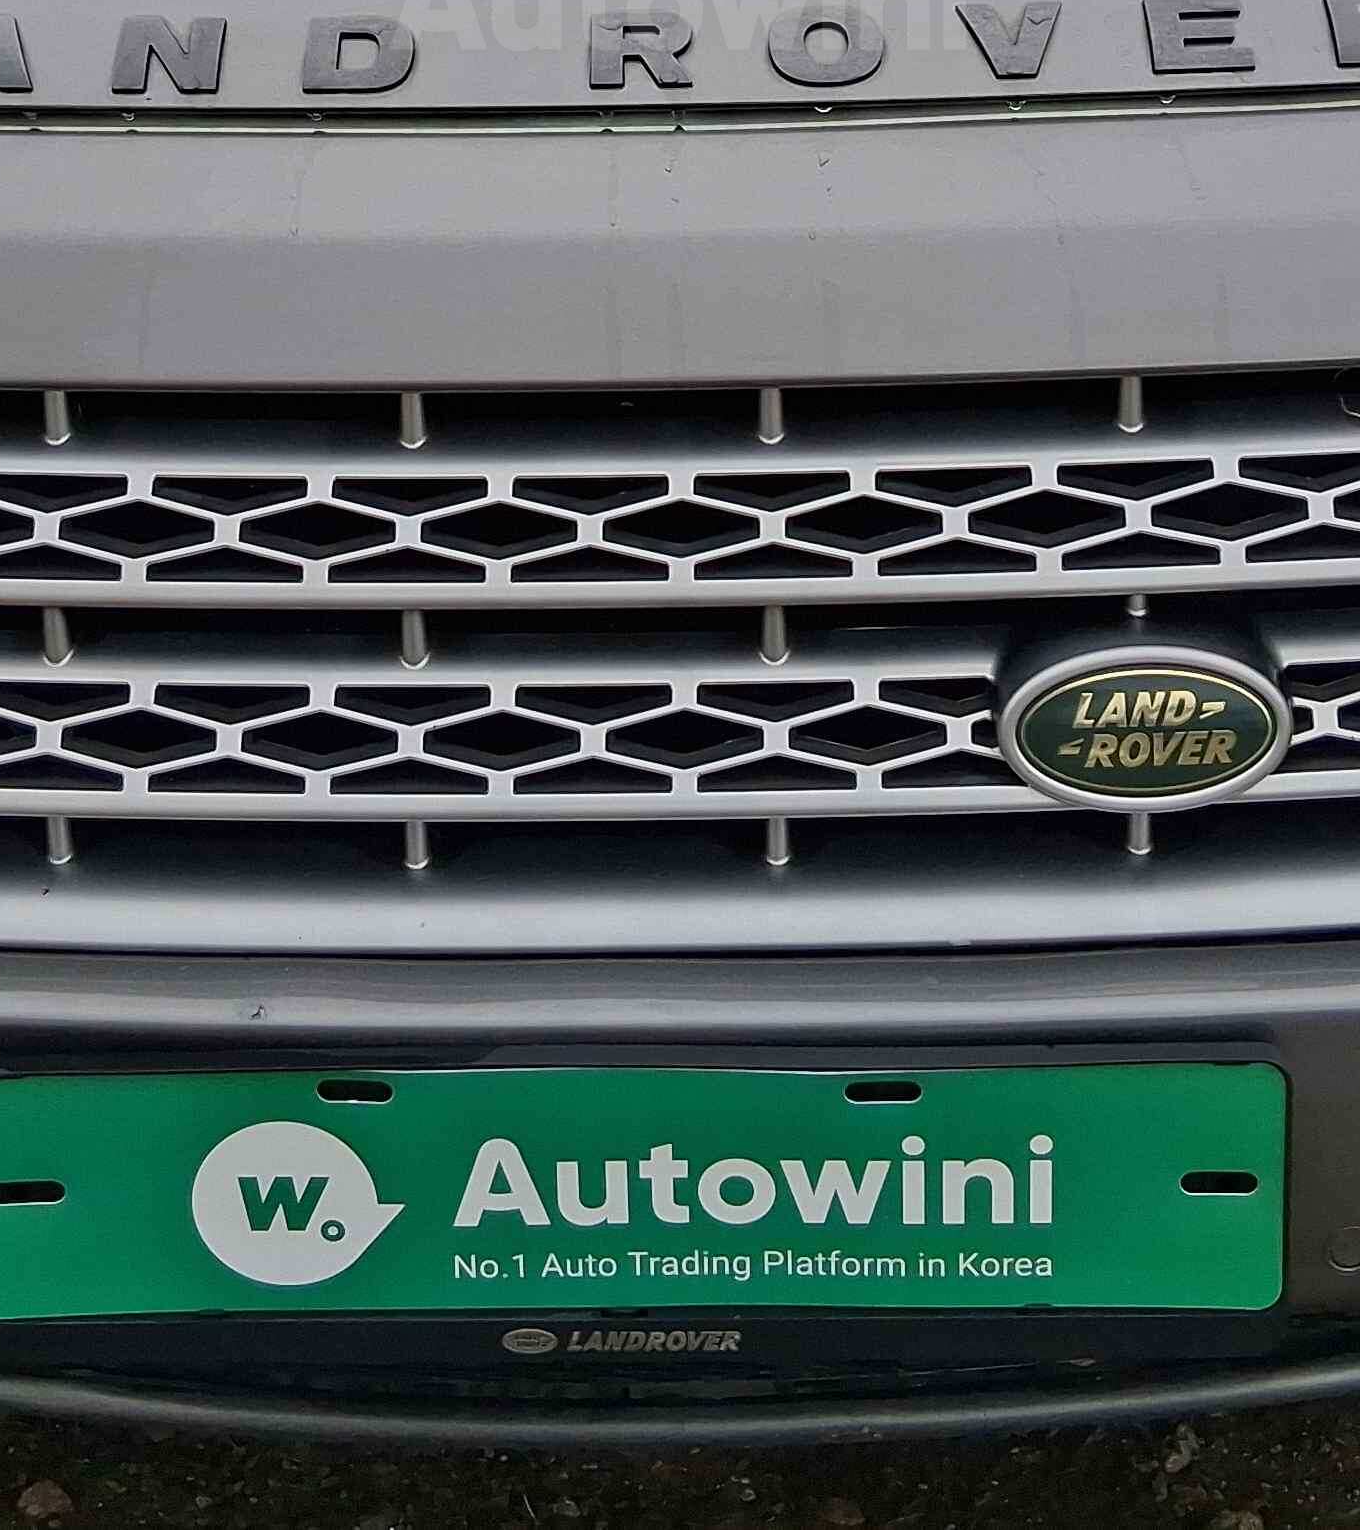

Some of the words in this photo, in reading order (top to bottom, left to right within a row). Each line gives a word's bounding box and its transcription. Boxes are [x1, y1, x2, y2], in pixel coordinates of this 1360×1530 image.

[1084, 728, 1238, 769] ROVER
[451, 1134, 1054, 1227] Autowini
[453, 1253, 527, 1279] No.1
[540, 1252, 618, 1278] Auto
[626, 1249, 752, 1282] Trading
[762, 1249, 906, 1278] Platform
[918, 1252, 946, 1278] in
[958, 1251, 1054, 1278] Korea
